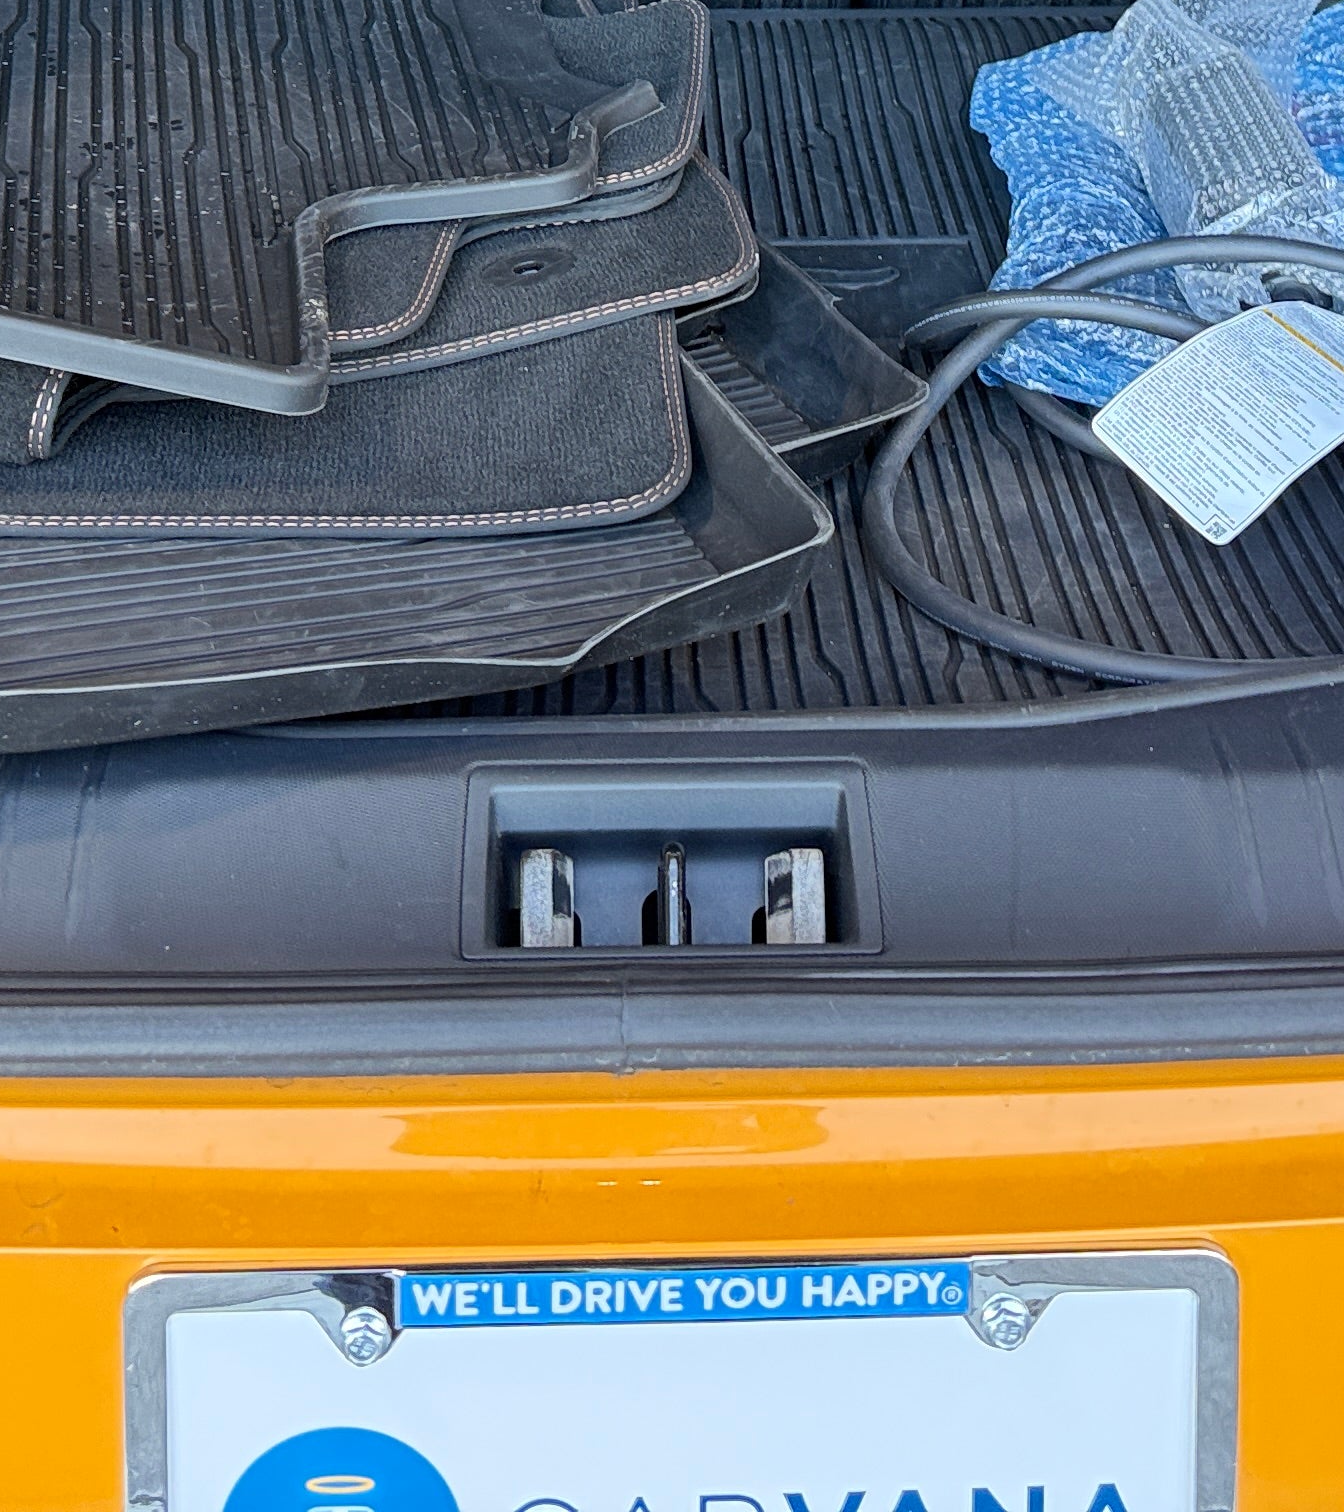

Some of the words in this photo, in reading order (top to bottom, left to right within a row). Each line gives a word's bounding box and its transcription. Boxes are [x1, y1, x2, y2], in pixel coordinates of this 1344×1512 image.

[412, 1282, 540, 1316] WE'LL
[551, 1278, 684, 1314] DRIVE
[695, 1276, 787, 1310] YOU
